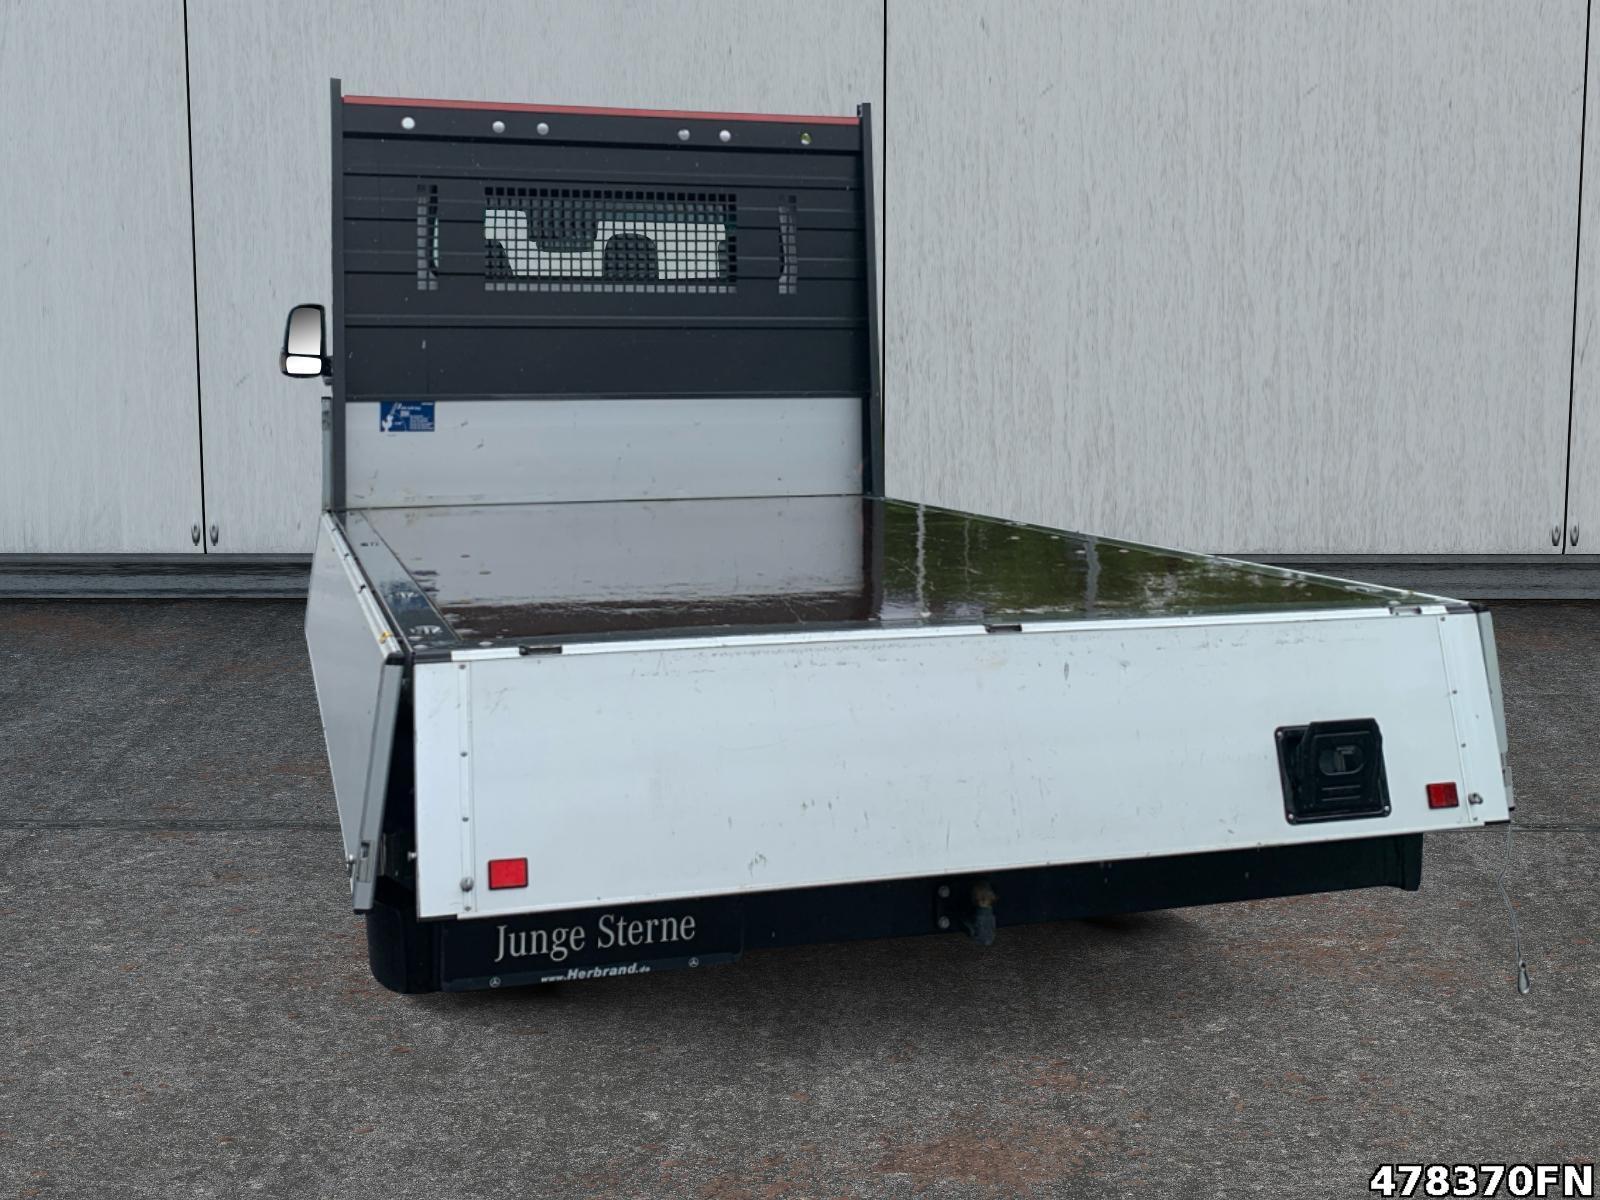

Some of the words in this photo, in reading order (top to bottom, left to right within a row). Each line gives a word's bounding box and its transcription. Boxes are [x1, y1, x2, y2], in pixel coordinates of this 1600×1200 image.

[494, 924, 585, 962] Junge
[597, 913, 696, 949] Sterne
[541, 962, 651, 983] www.Herbrand.de
